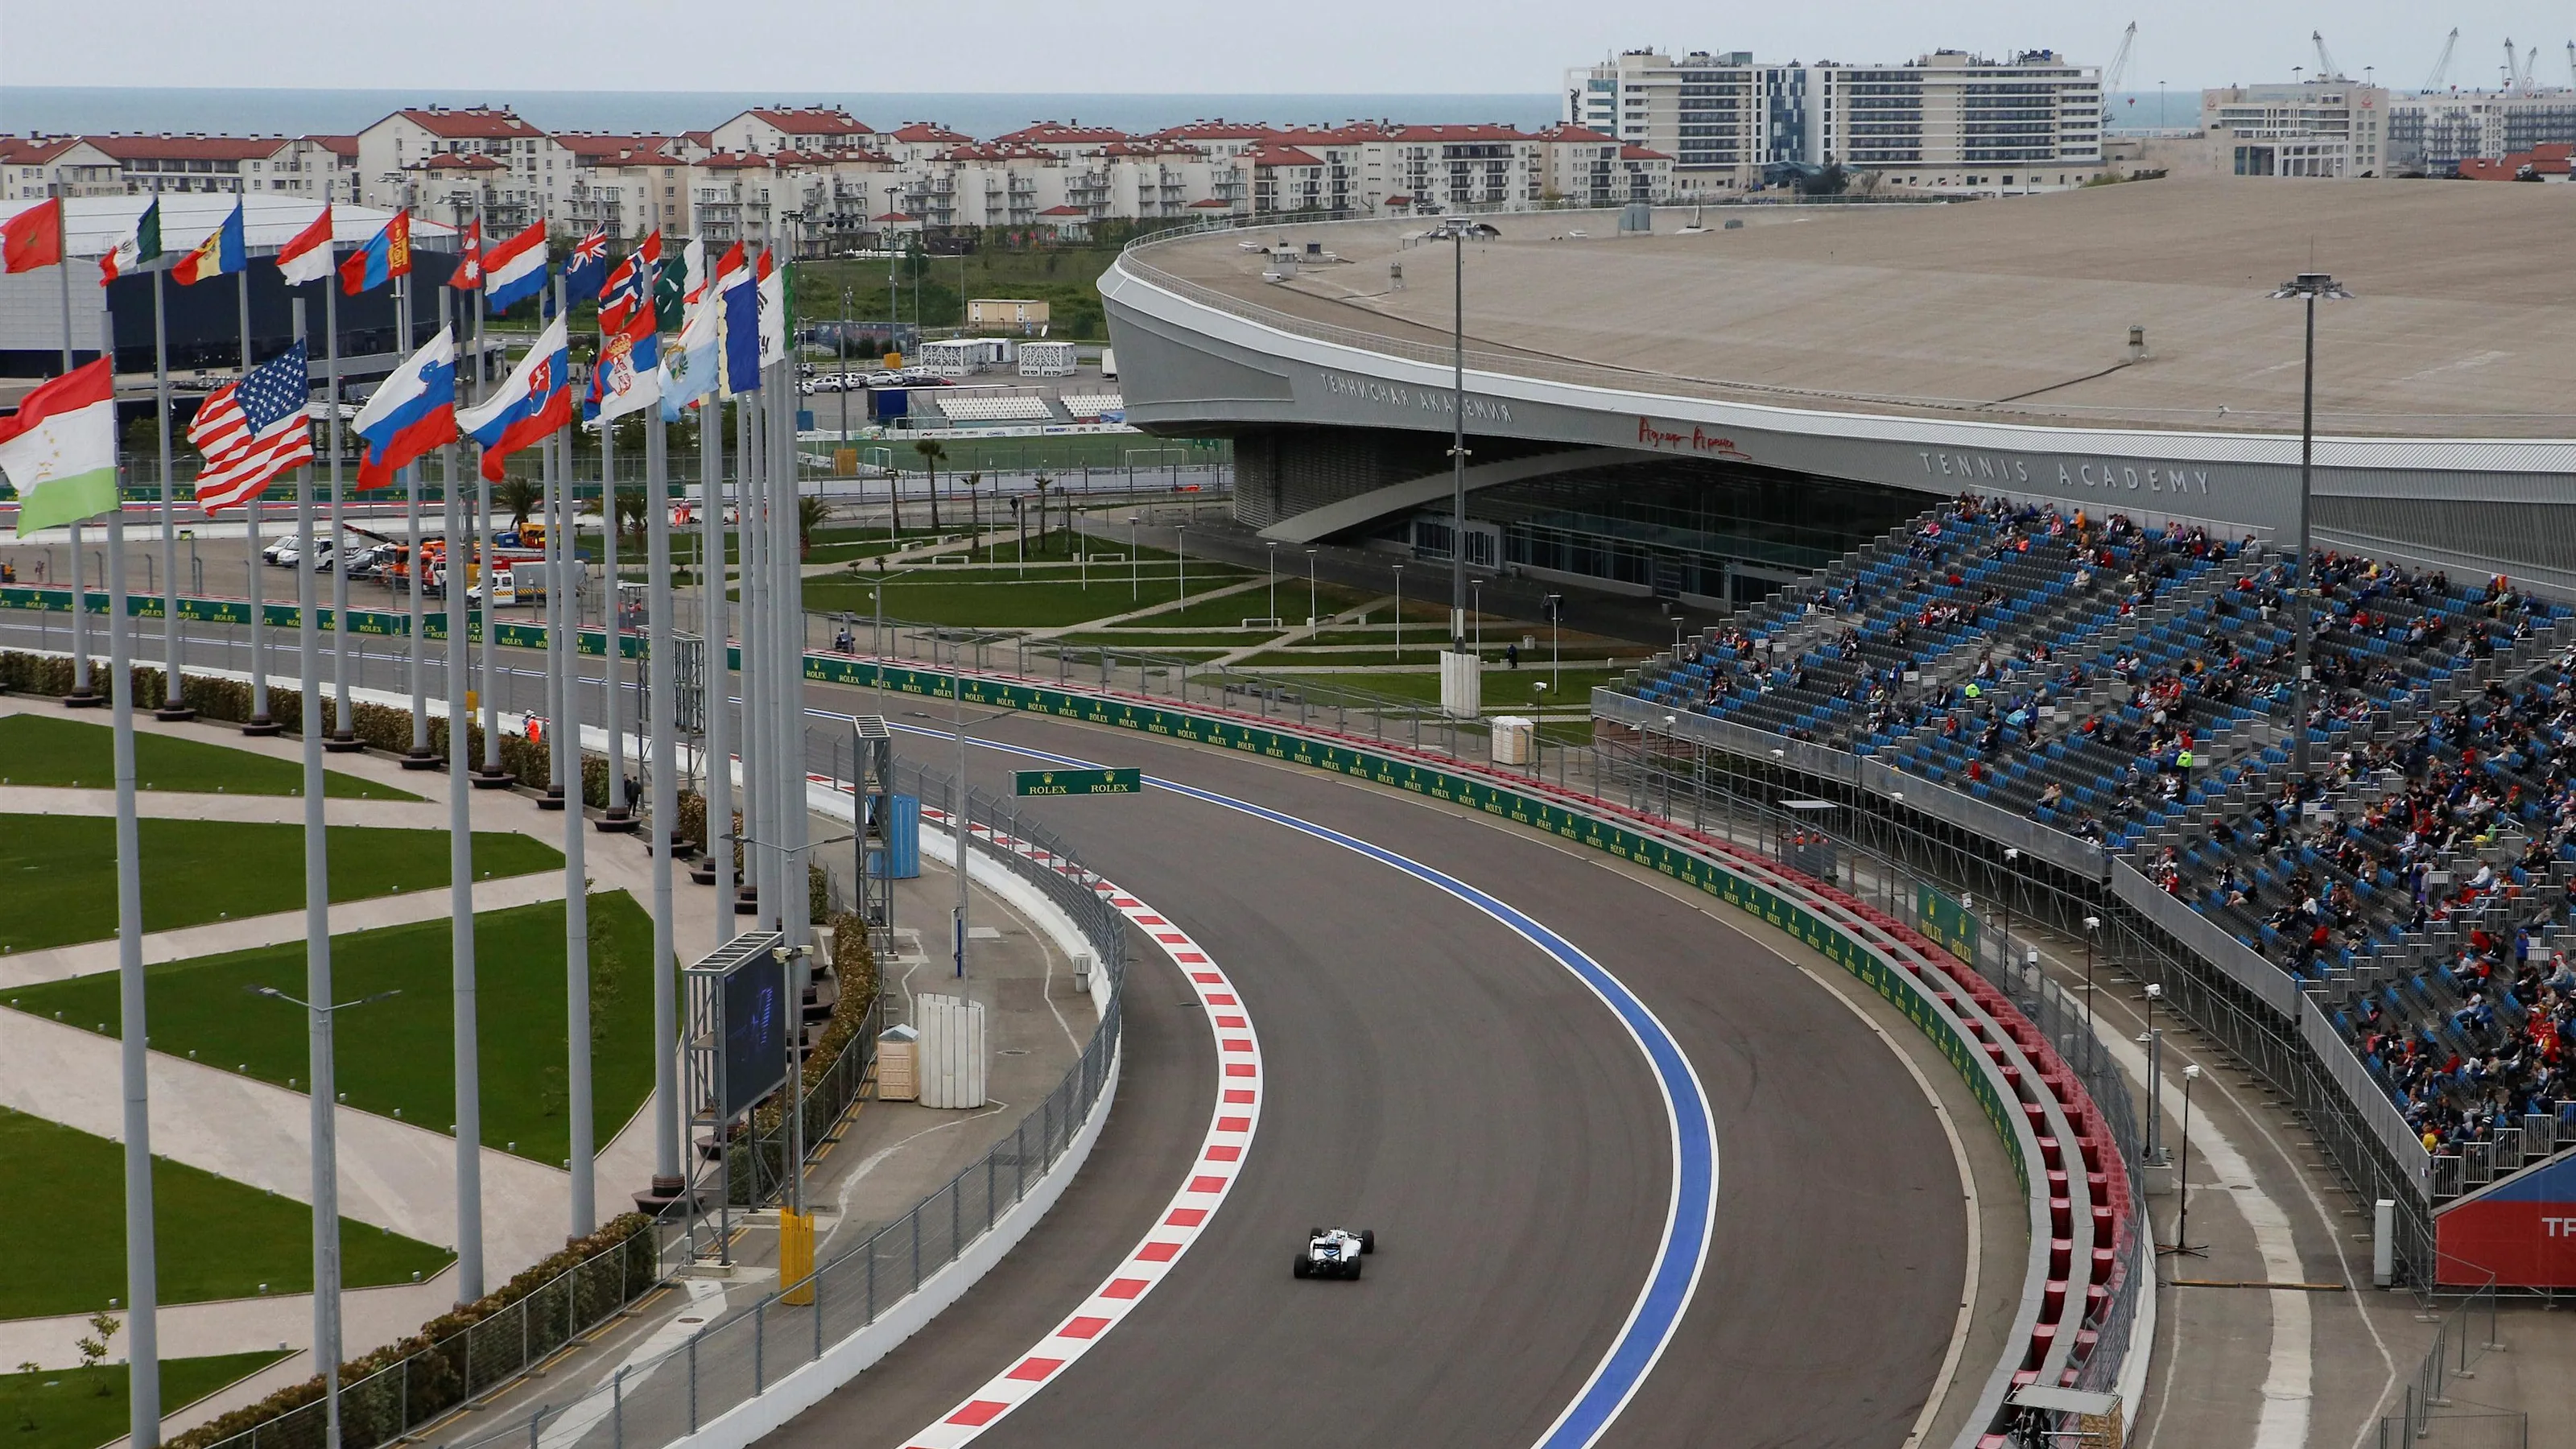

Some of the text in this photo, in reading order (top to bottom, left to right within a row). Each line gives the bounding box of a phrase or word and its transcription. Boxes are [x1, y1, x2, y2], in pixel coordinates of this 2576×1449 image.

[1321, 374, 1410, 407] ТЕННИСНАЯ
[1920, 452, 2208, 494] TENNIS ACADEMY
[178, 612, 200, 620] ROLEX
[213, 614, 237, 622] ROLEX
[359, 625, 382, 634] ROLEX
[502, 637, 523, 646] ROLEX
[807, 670, 826, 680] ROLEX
[839, 675, 859, 685] ROLEX
[902, 683, 922, 694] ROLEX
[933, 688, 953, 698] ROLEX
[965, 693, 985, 703] ROLEX
[997, 697, 1016, 708] ROLEX
[1028, 702, 1048, 713] ROLEX
[1059, 707, 1077, 718] ROLEX
[1089, 713, 1108, 724] ROLEX
[1119, 718, 1138, 729] ROLEX
[1149, 723, 1168, 734] ROLEX
[1177, 729, 1197, 740] ROLEX
[1208, 735, 1226, 746] ROLEX
[1237, 741, 1256, 752] ROLEX
[1266, 747, 1284, 758] ROLEX
[1294, 753, 1312, 765] ROLEX
[1322, 759, 1340, 772] ROLEX
[1350, 766, 1368, 778] ROLEX
[1377, 772, 1395, 785] ROLEX
[1029, 784, 1128, 795] ROLEX ROLEX
[1404, 780, 1422, 793] ROLEX
[1432, 787, 1449, 799] ROLEX
[1459, 795, 1476, 807] ROLEX
[1485, 803, 1503, 815] ROLEX
[1512, 810, 1528, 823] ROLEX
[1537, 818, 1552, 831] ROLEX
[1561, 827, 1577, 840] ROLEX
[1586, 836, 1603, 848] ROLEX
[1610, 843, 1626, 857] ROLEX
[1634, 852, 1651, 866] ROLEX
[1659, 861, 1674, 875] ROLEX
[1682, 871, 1697, 885] ROLEX
[1703, 881, 1717, 896] ROLEX
[1724, 891, 1739, 905] ROLEX
[1745, 901, 1760, 916] ROLEX
[1767, 911, 1781, 926] ROLEX
[1788, 922, 1800, 937] ROLEX
[1922, 919, 1942, 944] ROLEX
[1952, 939, 1972, 964] ROLEX
